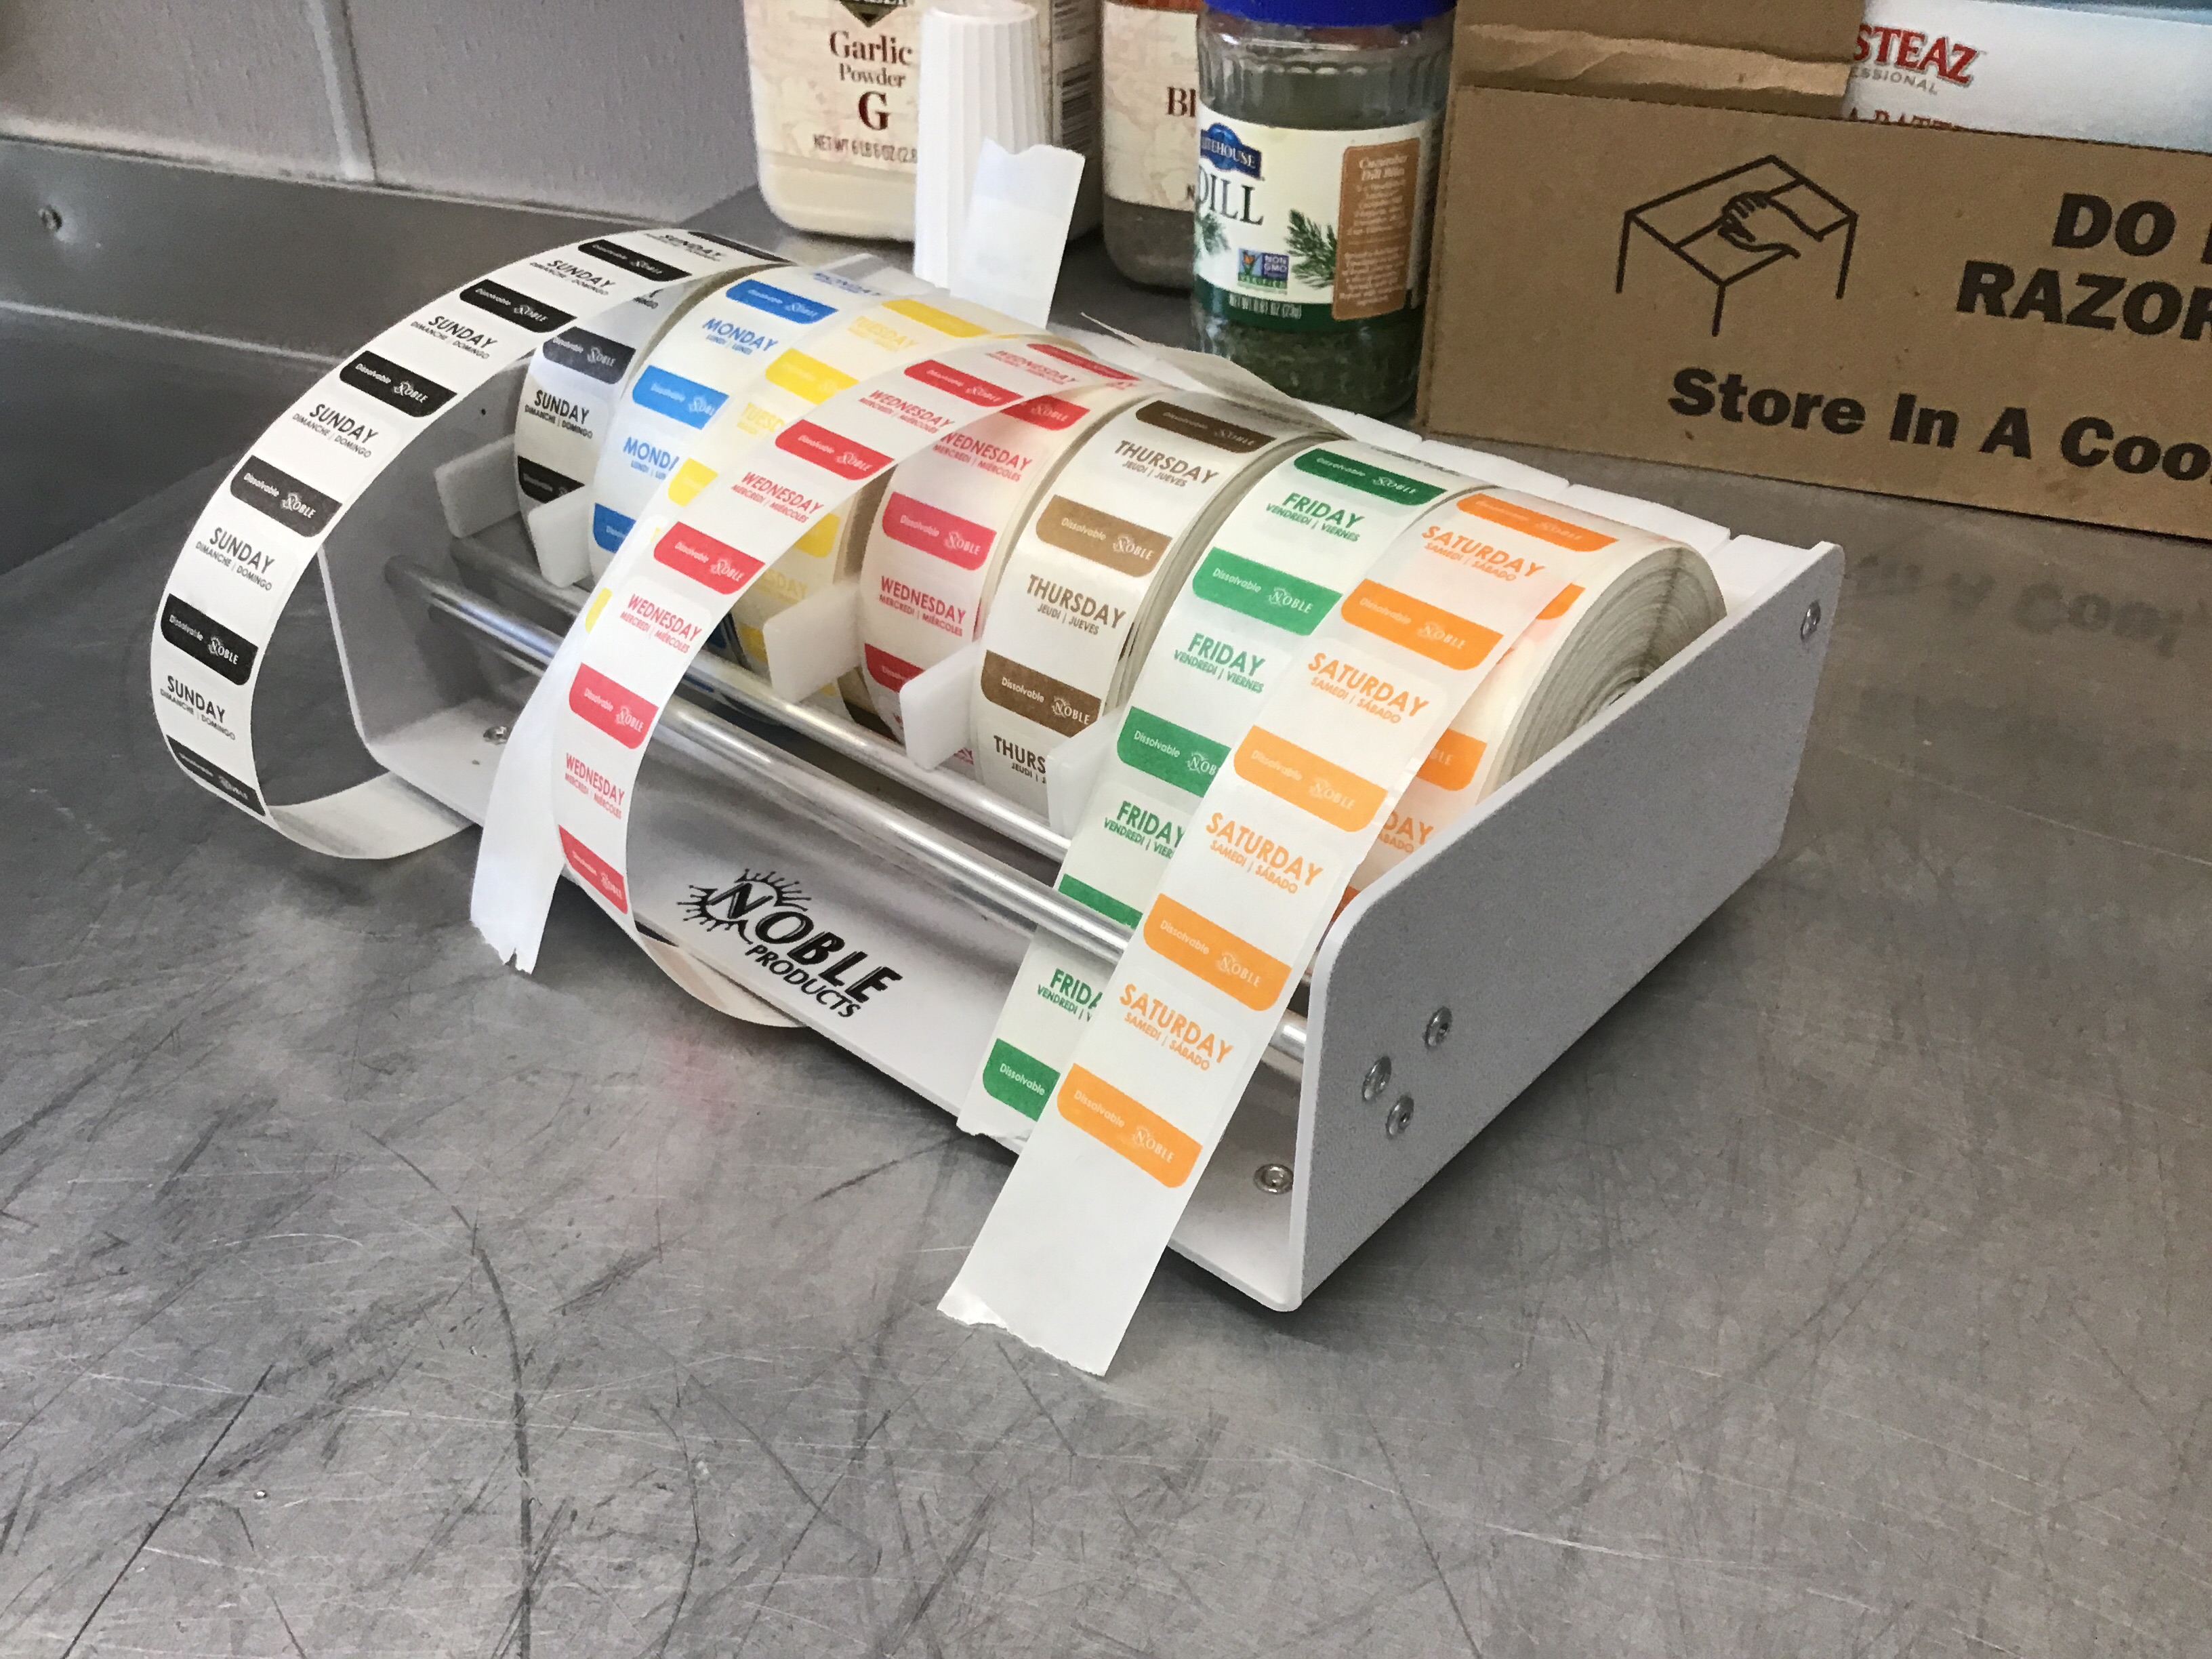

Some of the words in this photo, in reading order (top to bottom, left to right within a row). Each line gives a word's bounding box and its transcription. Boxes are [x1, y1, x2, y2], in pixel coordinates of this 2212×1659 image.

[830, 30, 914, 66] Garlic
[839, 62, 906, 88] Powder
[858, 91, 891, 130] G
[2052, 192, 2175, 257] DO
[548, 260, 616, 287] SUNDAY
[1956, 260, 2212, 341] RAZOR
[428, 316, 497, 348] SUNDAY
[703, 317, 779, 351] MONDAY
[309, 404, 378, 443] SUNDAY
[534, 390, 590, 424] SUNDAY
[562, 419, 593, 439] DOMINGO
[869, 390, 955, 427] WEDNESDAY
[1668, 366, 1866, 435] Store
[1889, 393, 1959, 449] In
[1979, 407, 2032, 459] A
[2060, 416, 2212, 483] Coo
[292, 413, 329, 436] DIMANCHE
[333, 434, 371, 458] DOMINGO
[623, 436, 679, 471] MOND
[1114, 440, 1218, 484] THURSDAY
[1122, 460, 1148, 473] JEUDI
[1154, 472, 1188, 487] JUEVES
[741, 472, 824, 514] WEDNESDAY
[1266, 503, 1313, 525] VENDREDI
[1282, 492, 1365, 529] FRIDAY
[209, 527, 275, 575] SUNDAY
[1061, 517, 1106, 541] Dissolvable
[1112, 533, 1155, 561] NOBLE
[1421, 525, 1546, 577] SATURDAY
[196, 541, 231, 569] DIMANCHE
[237, 565, 272, 591] DOMINGO
[879, 594, 914, 617] MERCREDI
[881, 575, 966, 625] WEDNESDAY
[1027, 573, 1126, 630] THURSDAY
[1212, 567, 1262, 594] Dissolvable
[1268, 586, 1314, 615] NOBLE
[628, 594, 702, 642] WEDNESDAY
[1037, 602, 1061, 619] JEUDI
[1069, 615, 1101, 636] JUEVES
[1359, 597, 1412, 625] Dissolvable
[1416, 619, 1466, 650] NOBLE
[1174, 649, 1217, 675] VENDREDI
[1227, 671, 1265, 693] VIERNES
[1187, 632, 1266, 677] FRIDAY
[167, 676, 226, 723] SUNDAY
[1001, 677, 1044, 703] Dissolvable
[1051, 696, 1090, 726] NOBLE
[1307, 652, 1430, 718] SATURDAY
[1311, 676, 1350, 701] SAMEDI
[1357, 696, 1401, 724] SÁBADO
[201, 714, 236, 741] DOMINGO
[617, 705, 644, 733] NOBLE
[994, 735, 1046, 774] THURS
[1011, 762, 1033, 778] JEUDI
[1134, 729, 1180, 758] Dissolvable
[1185, 750, 1218, 775] NOB
[566, 753, 625, 806] WEDNESDAY
[1251, 749, 1303, 781] Dissolvable
[1309, 777, 1356, 811] NOBLE
[1104, 817, 1145, 846] VENDREDI
[1153, 841, 1175, 860] VIER
[1117, 800, 1185, 848] FRIDAY
[1206, 812, 1324, 887] SATURDAY
[1210, 840, 1248, 867] SAMEDI
[1255, 863, 1298, 895] SÁBADO
[708, 881, 904, 1004] NOBLE
[1160, 919, 1210, 956] Dissolvable
[1216, 950, 1262, 988] NOBLE
[745, 943, 862, 1019] PRODUCTS
[1037, 984, 1078, 1015] VENDREDI
[1050, 967, 1103, 1010] FRID
[1120, 983, 1234, 1065] SATURDAY
[1124, 1011, 1161, 1042] SAMEDI
[1169, 1036, 1210, 1071] SÁBADO
[1000, 1063, 1046, 1097] Dissolvable
[1073, 1088, 1125, 1129] Dissolvable
[1131, 1124, 1176, 1164] NOBLE
